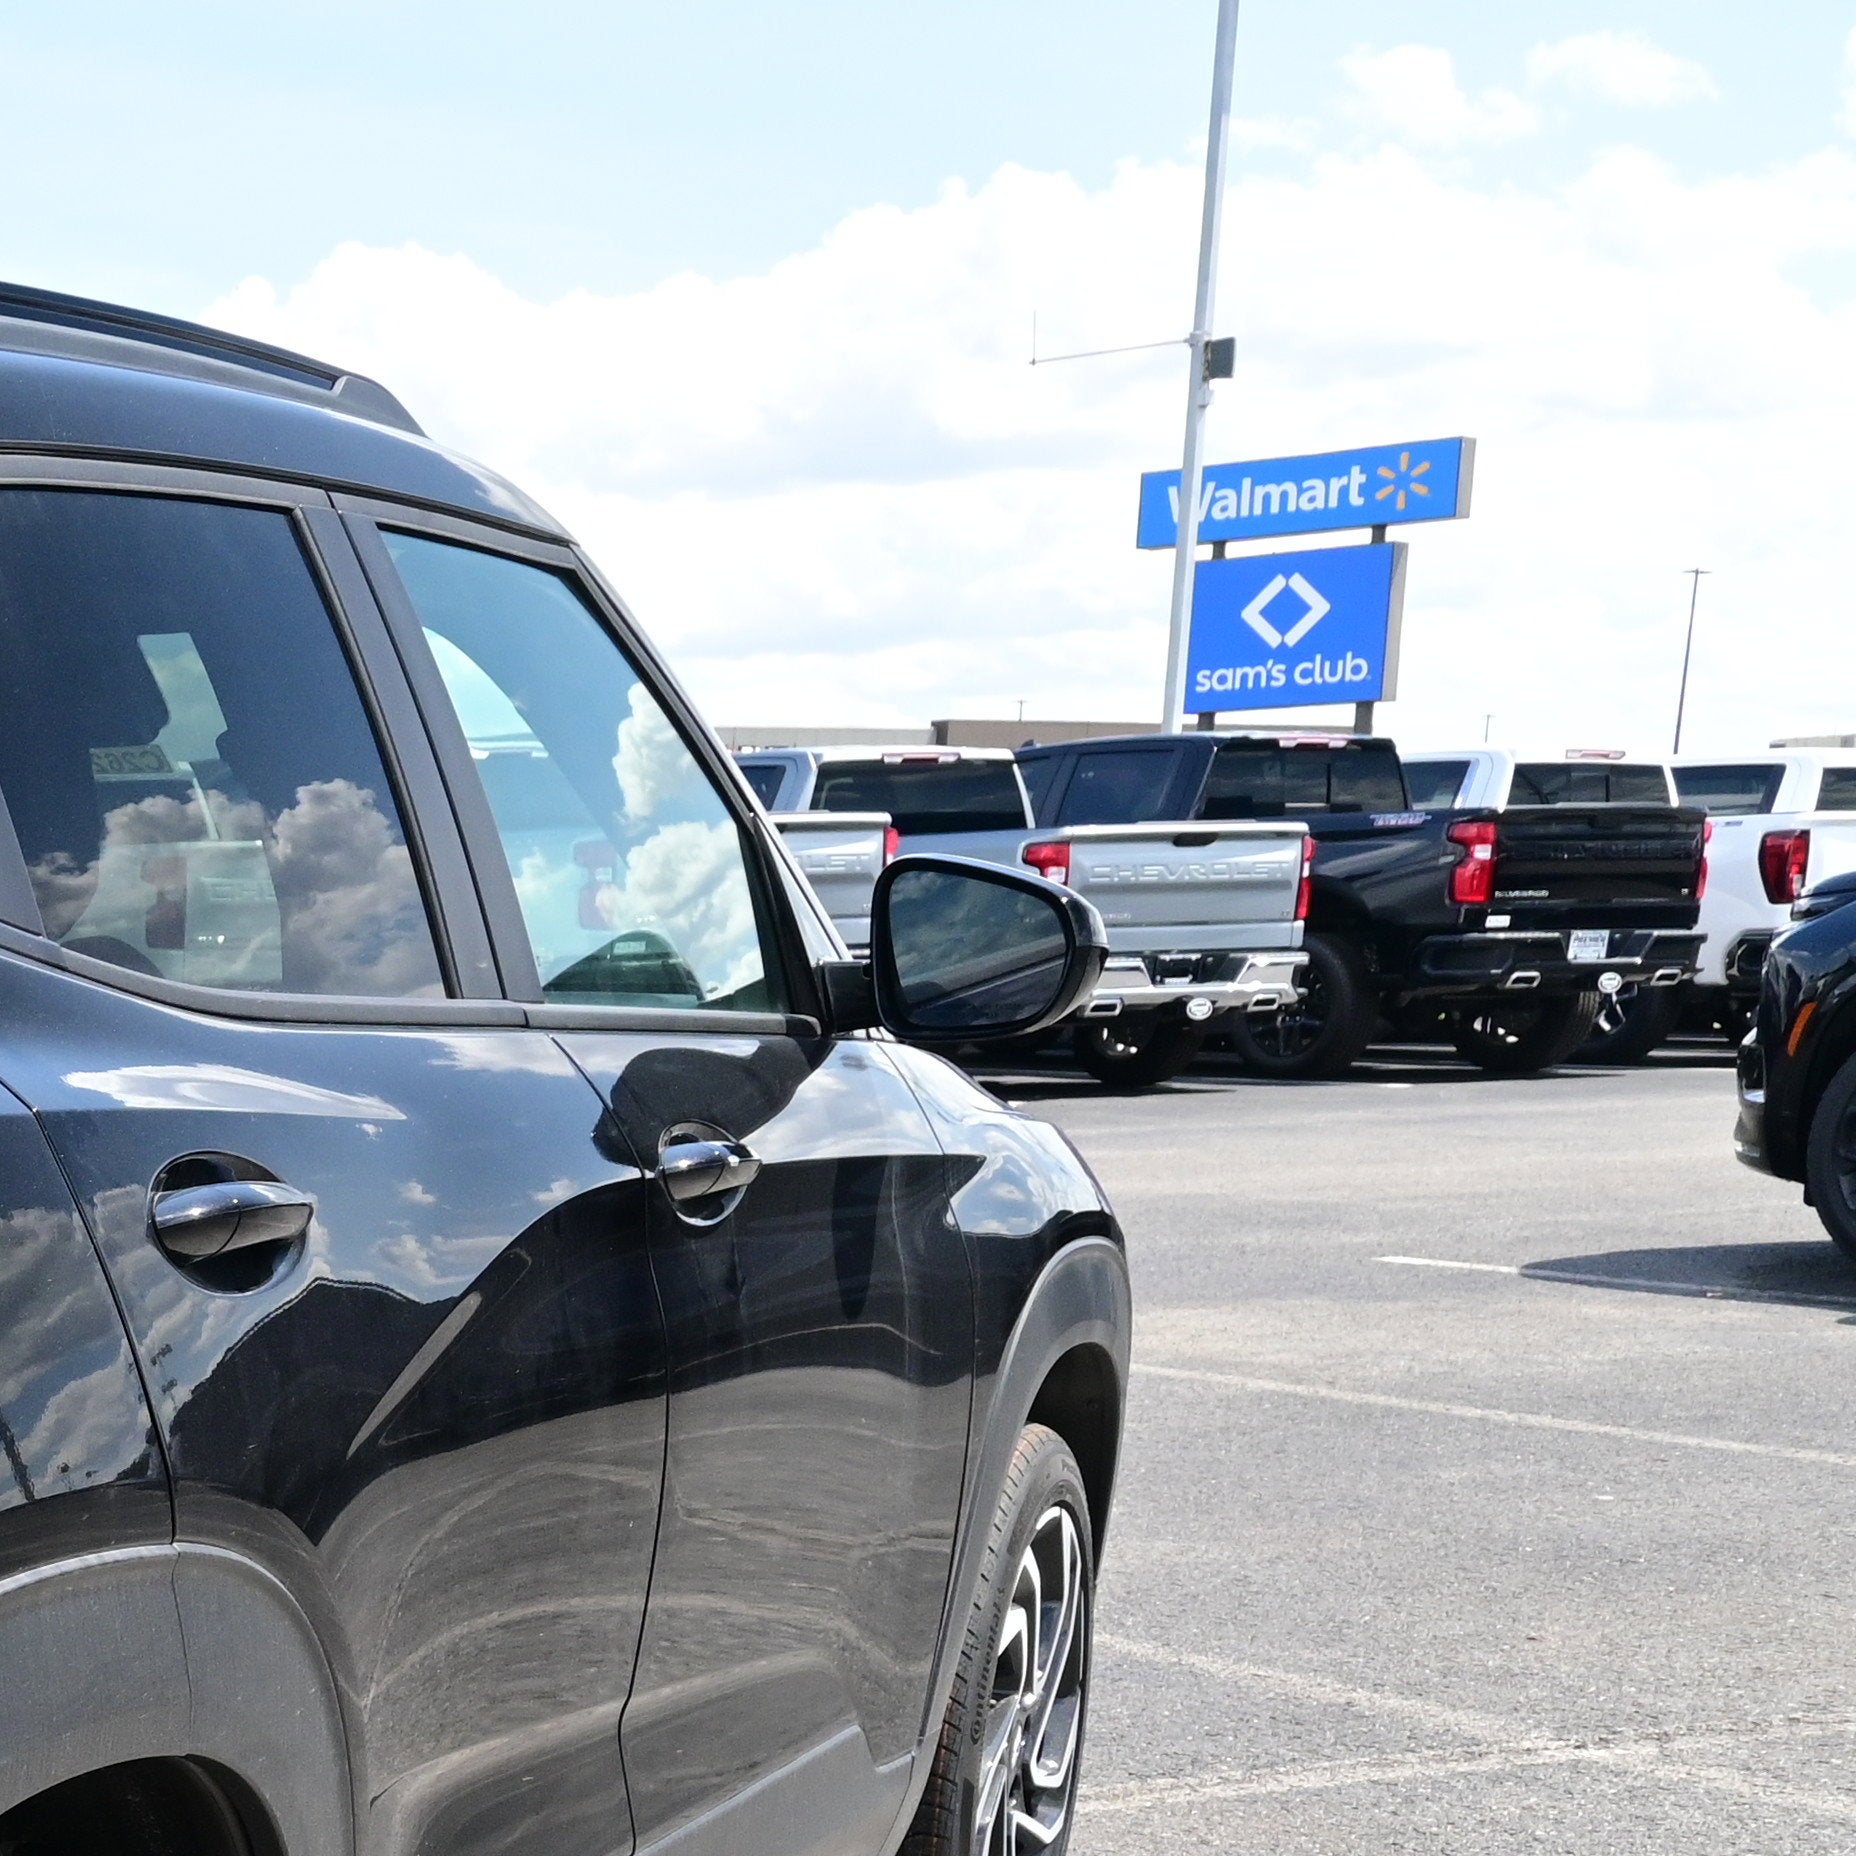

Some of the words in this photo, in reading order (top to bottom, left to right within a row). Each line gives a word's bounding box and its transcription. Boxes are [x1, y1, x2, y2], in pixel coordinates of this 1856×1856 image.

[1195, 658, 1287, 693] sam's
[1293, 650, 1369, 685] club
[1089, 862, 1289, 882] CHEVROLET
